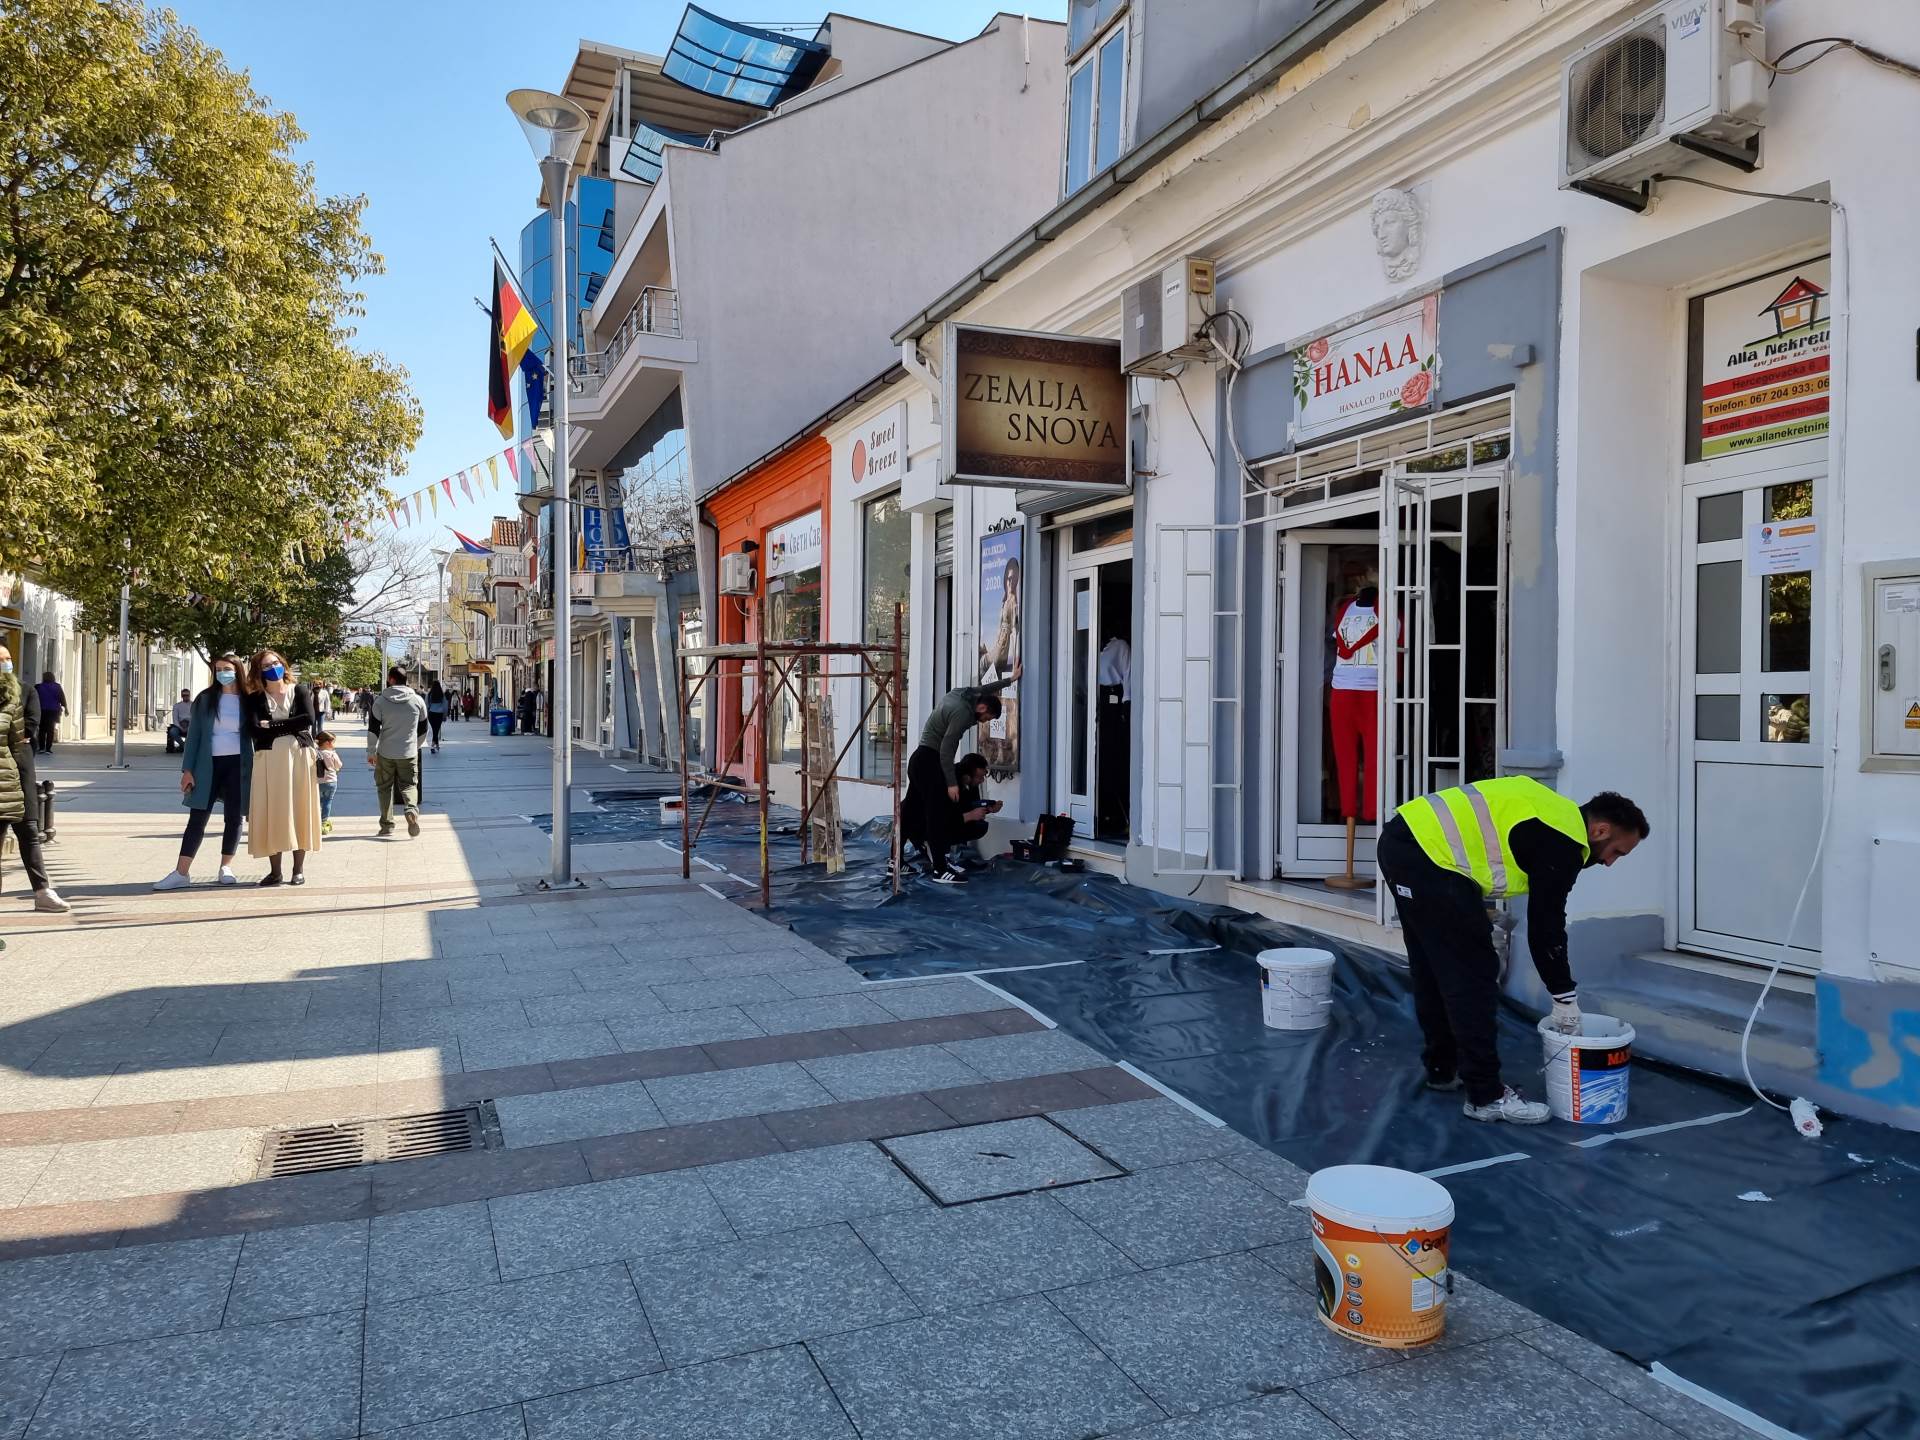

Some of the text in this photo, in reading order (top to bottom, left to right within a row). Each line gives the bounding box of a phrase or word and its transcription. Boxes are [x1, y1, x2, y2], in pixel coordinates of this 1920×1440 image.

[1671, 3, 1707, 29] VIVAX
[1313, 333, 1419, 398] HANAA
[1727, 351, 1758, 367] Alla
[964, 373, 1088, 412] ZEMLJA
[1708, 399, 1748, 415] Telefon:
[1750, 393, 1767, 405] 067
[1770, 388, 1788, 401] 204
[1792, 383, 1814, 396] 933;
[870, 422, 895, 450] Sweet
[1007, 413, 1120, 448] SNOVA
[868, 450, 897, 476] Breeze
